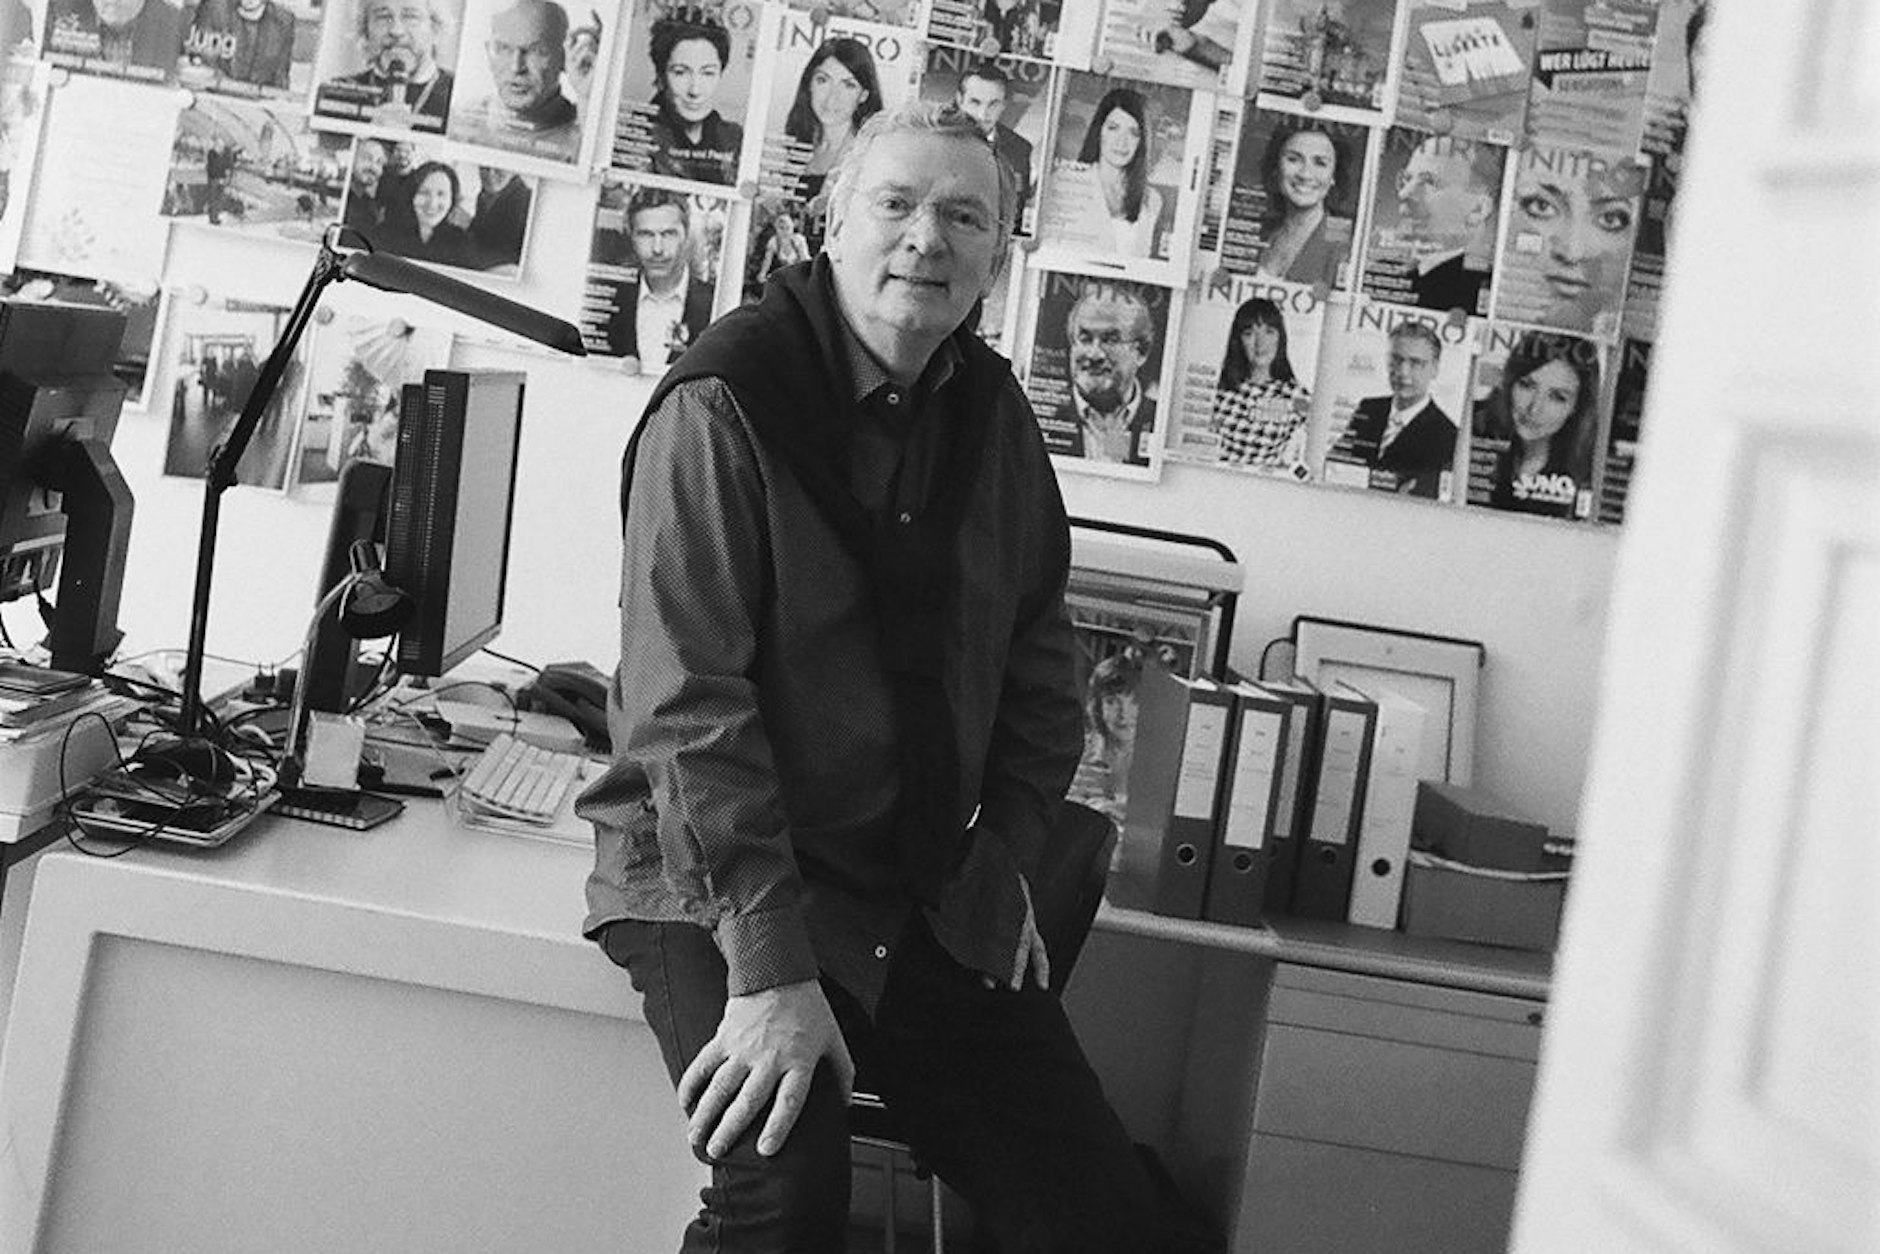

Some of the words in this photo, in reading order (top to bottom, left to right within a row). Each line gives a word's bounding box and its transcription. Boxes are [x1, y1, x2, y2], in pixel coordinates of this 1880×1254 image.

[184, 25, 237, 60] Jung
[1053, 274, 1165, 308] NITRO
[1207, 278, 1317, 314] NITRO
[1358, 306, 1466, 344] NITRO
[1489, 328, 1597, 364] NITRO
